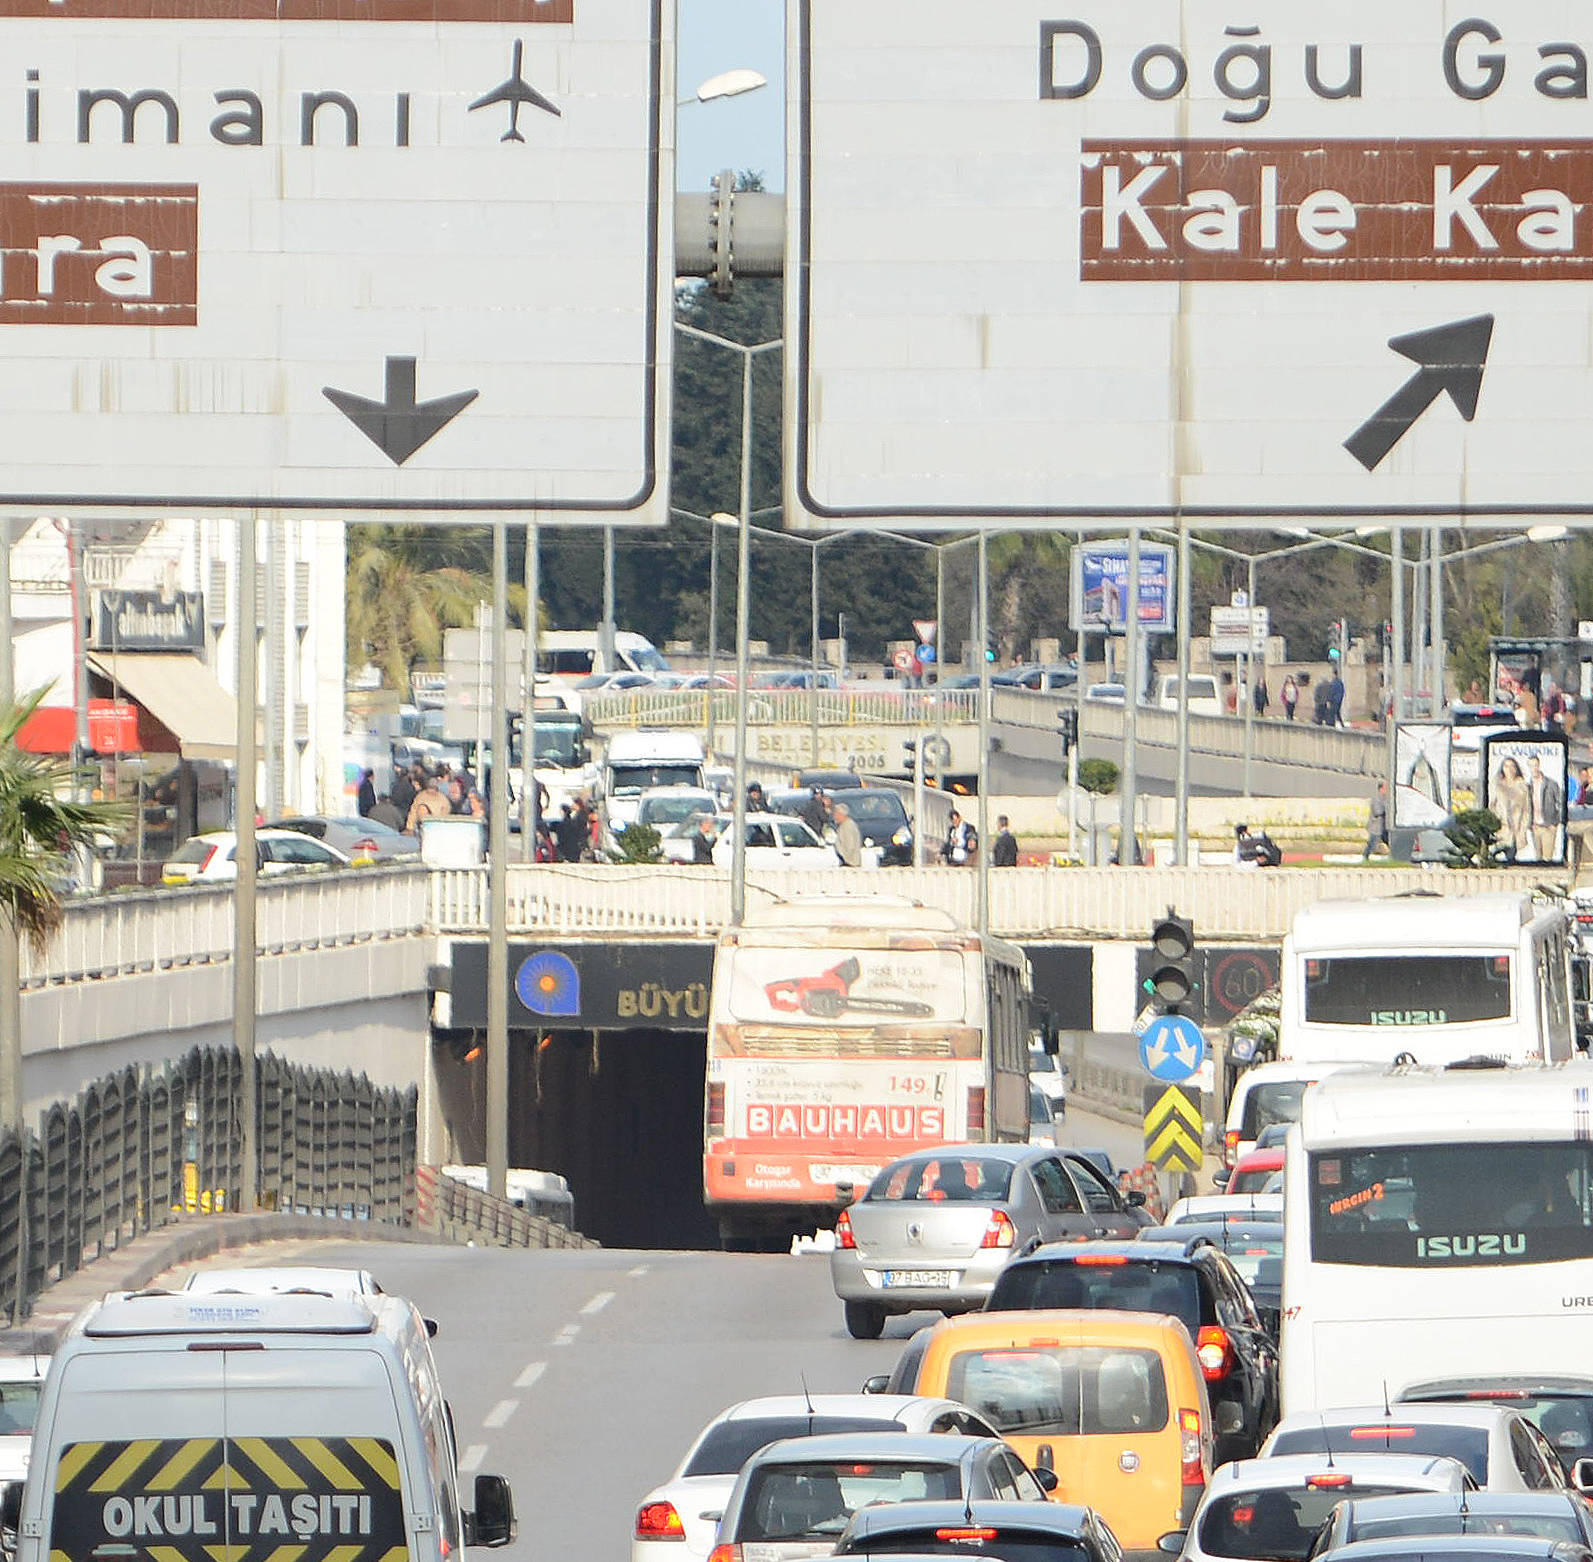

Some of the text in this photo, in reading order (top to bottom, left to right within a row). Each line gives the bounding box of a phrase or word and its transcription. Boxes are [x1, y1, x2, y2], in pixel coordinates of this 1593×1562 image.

[1039, 19, 1363, 123] Doğu
[1101, 164, 1356, 253] Kale
[617, 982, 707, 1018] BÜYÜ
[1370, 1009, 1448, 1026] ISUZU
[748, 1105, 942, 1136] BAUHAUS
[1417, 1233, 1527, 1259] ISUZU
[102, 1494, 372, 1541] OKUL TAŞITI
